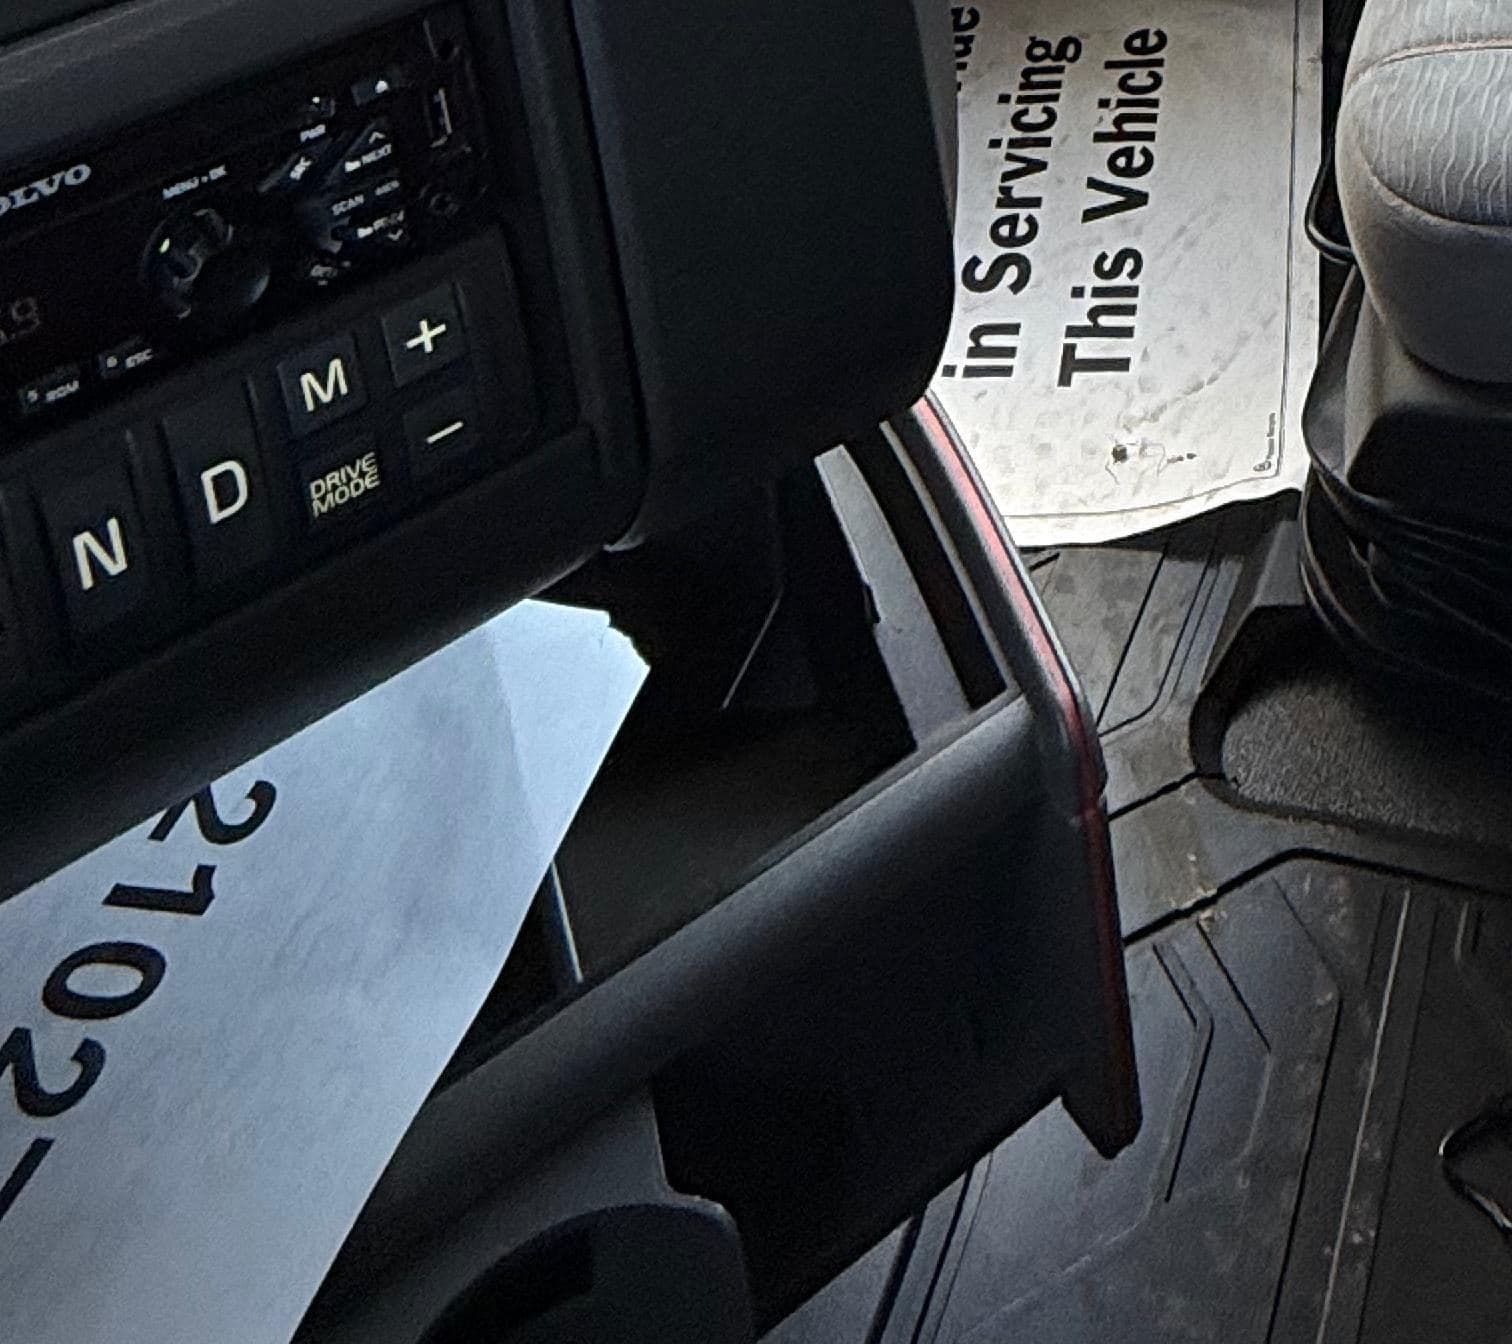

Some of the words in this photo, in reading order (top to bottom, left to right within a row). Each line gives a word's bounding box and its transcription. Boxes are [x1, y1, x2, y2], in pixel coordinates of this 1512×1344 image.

[1081, 27, 1168, 225] Vehicle
[960, 35, 1083, 296] Servicing
[331, 193, 365, 216] SCAN
[1056, 246, 1144, 388] This
[941, 320, 1023, 380] in
[299, 357, 349, 412] M
[199, 458, 249, 525] D
[310, 450, 377, 498] DRIVE
[311, 467, 381, 518] MODE
[72, 516, 129, 591] N
